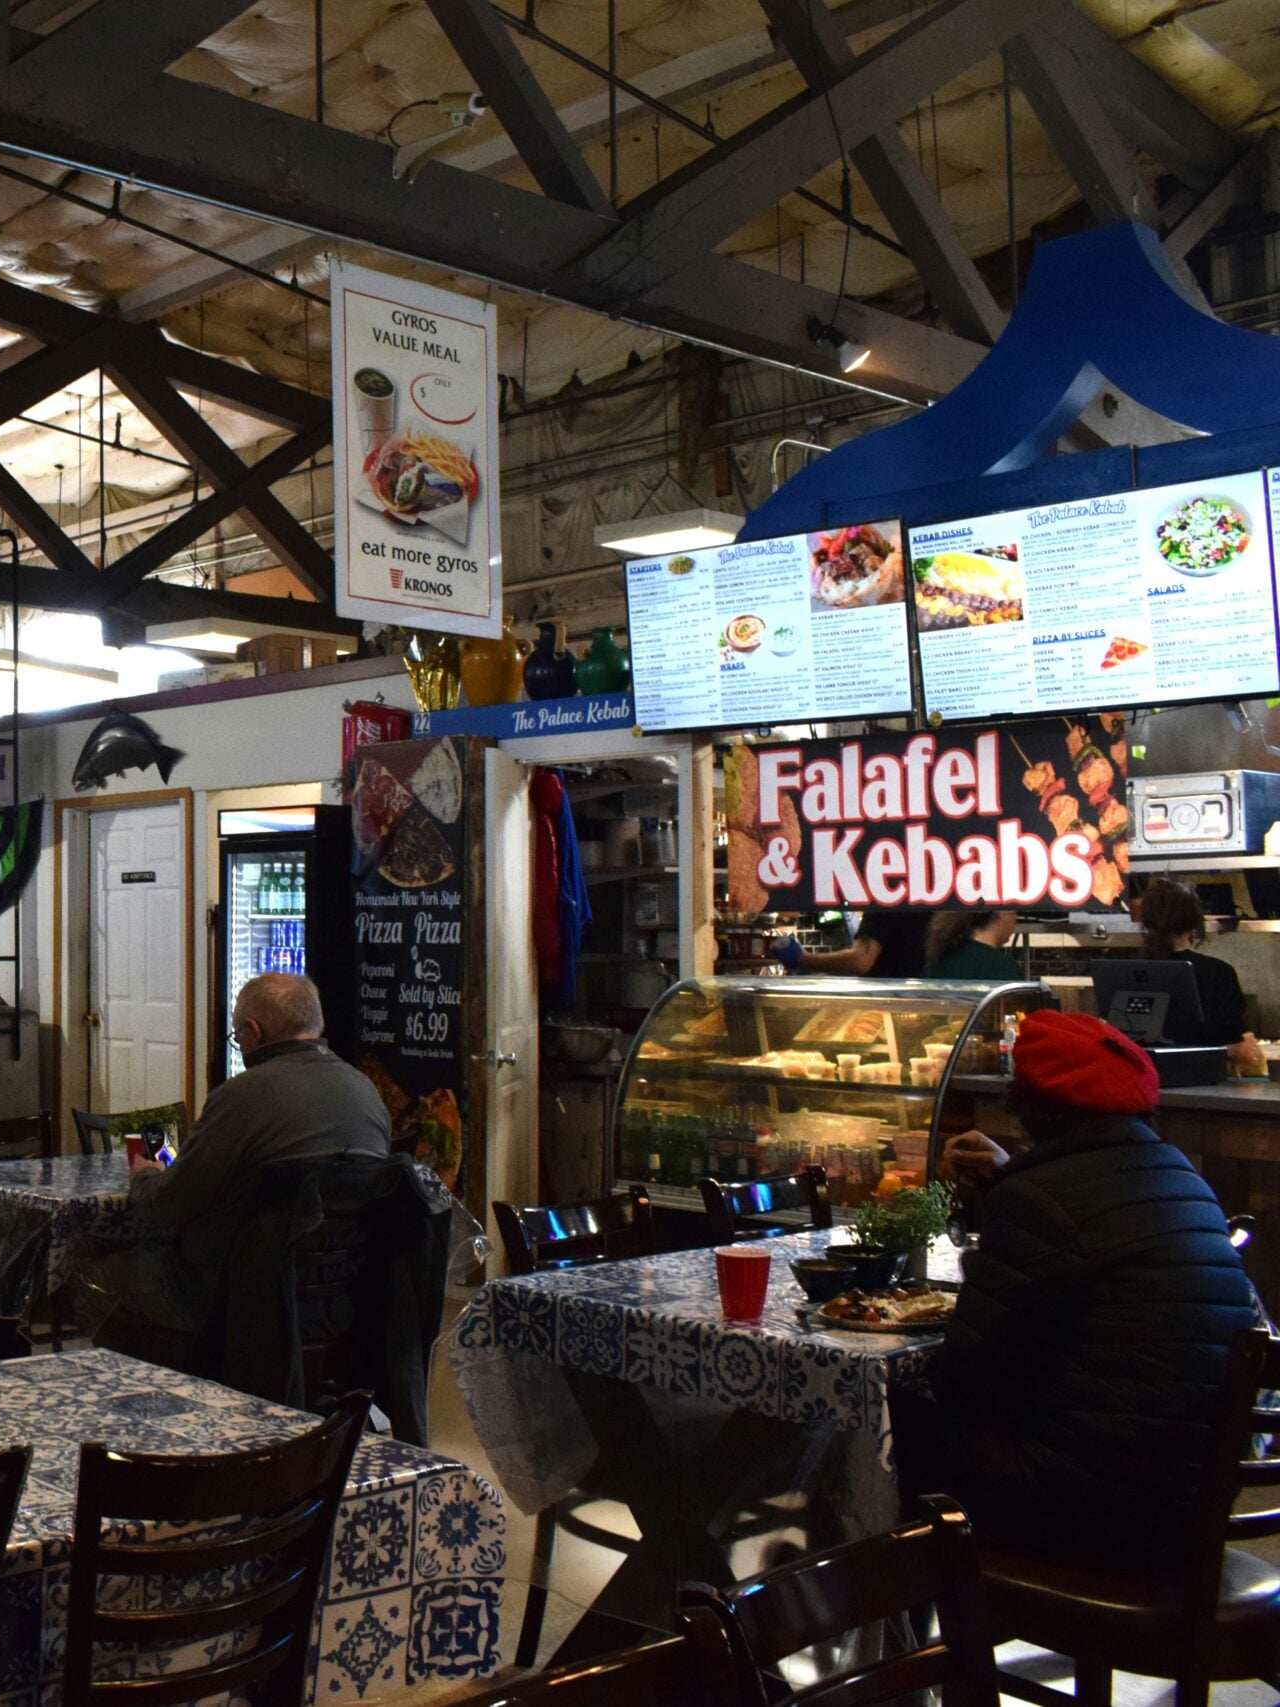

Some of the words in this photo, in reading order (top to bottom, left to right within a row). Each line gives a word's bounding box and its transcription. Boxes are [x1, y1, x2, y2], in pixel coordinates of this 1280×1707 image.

[392, 310, 438, 335] GYROS
[372, 327, 419, 353] VALUE
[422, 341, 461, 364] MEAL
[434, 378, 452, 389] ONLY
[1027, 511, 1050, 529] The
[1049, 505, 1089, 523] Palace
[912, 531, 939, 544] KEBAB
[942, 526, 974, 539] DISHES
[361, 541, 386, 558] eat
[391, 546, 432, 566] more
[436, 555, 478, 574] gyros
[629, 563, 662, 575] STARTERS
[404, 577, 453, 597] KRONOS
[1147, 584, 1186, 597] SALADS
[1033, 634, 1059, 646] PIZZA
[1061, 632, 1071, 643] BY
[1074, 628, 1107, 641] SLICES
[720, 661, 746, 672] WRAPS
[415, 713, 429, 733] 22
[512, 710, 536, 733] The
[538, 706, 584, 730] Palace
[587, 698, 630, 724] Kebab
[757, 731, 1001, 826] Falafel
[757, 835, 802, 887] &
[812, 819, 1094, 906] Kebabs
[354, 891, 400, 907] Homemade
[401, 891, 419, 906] New
[420, 891, 439, 906] York
[440, 890, 461, 910] Style
[355, 912, 402, 944] Pizza
[414, 911, 461, 945] Pizza
[360, 961, 395, 980] Peperoni
[360, 983, 387, 999] Cheese
[398, 983, 421, 1004] Sold
[422, 985, 435, 1009] by
[360, 1005, 389, 1025] Veggie
[360, 1027, 395, 1046] Supreme
[405, 1011, 448, 1043] $6.99
